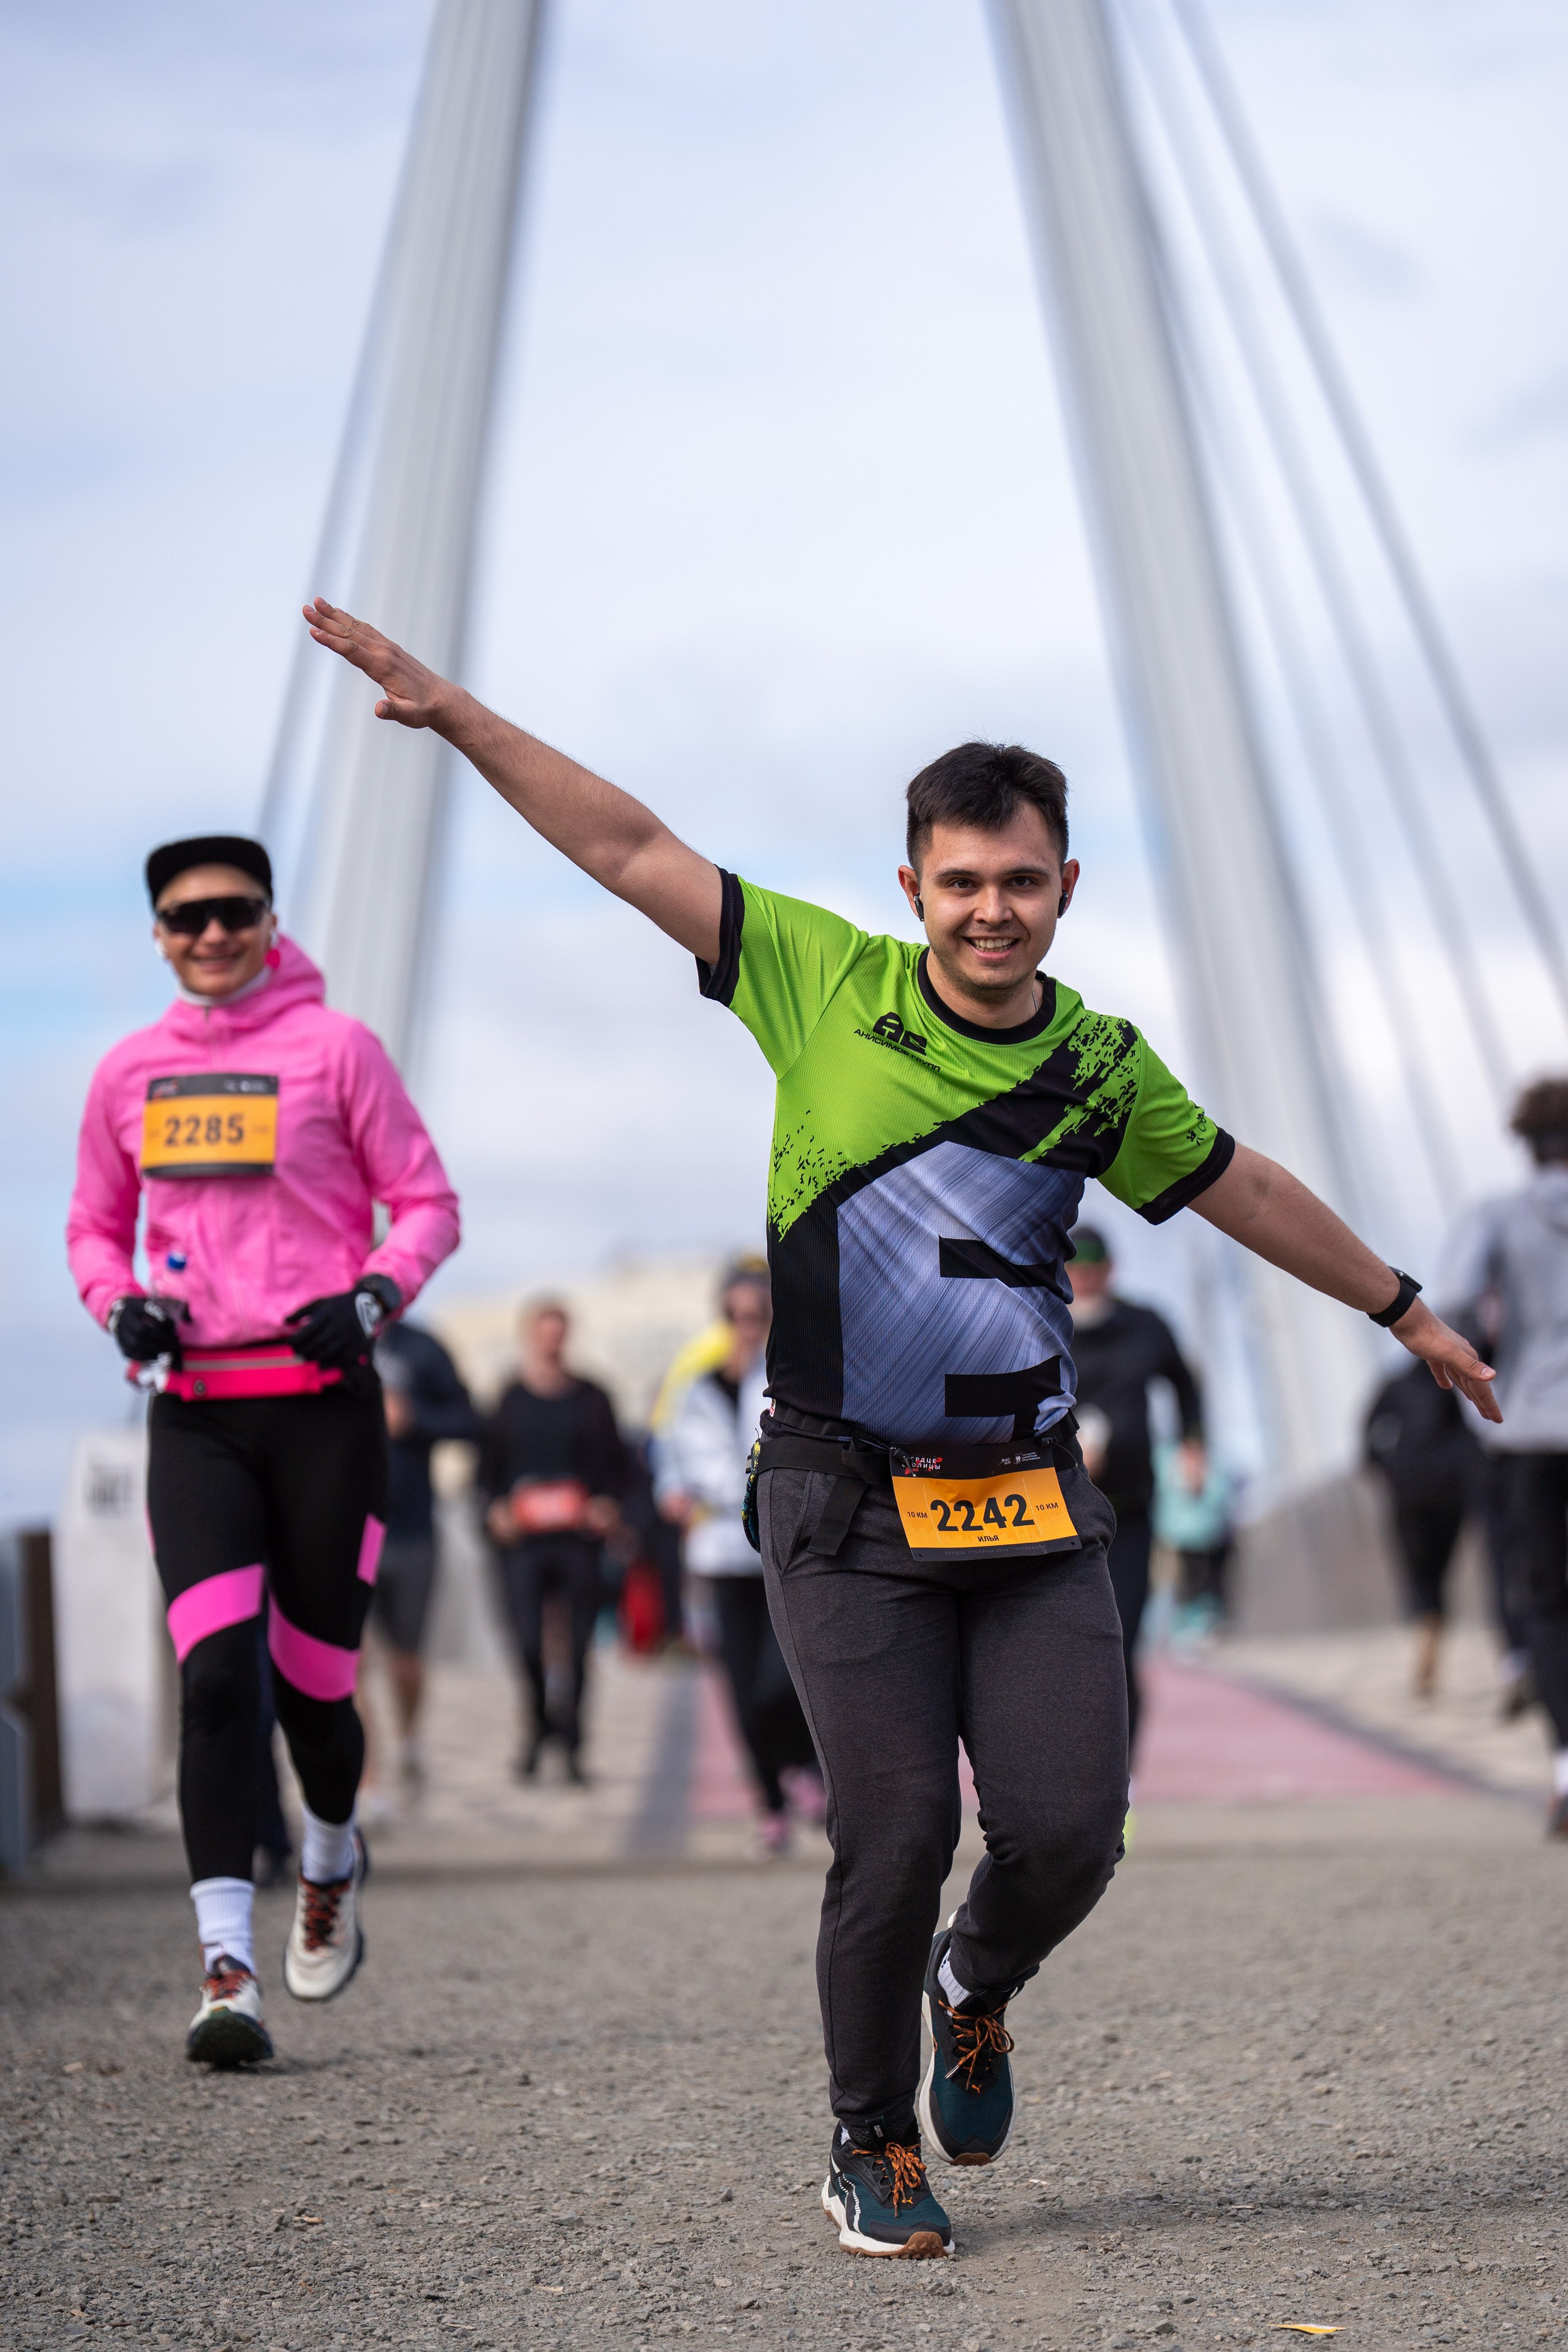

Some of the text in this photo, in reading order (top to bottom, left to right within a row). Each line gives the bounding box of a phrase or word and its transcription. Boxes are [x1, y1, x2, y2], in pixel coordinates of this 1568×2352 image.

[854, 1029, 910, 1056] АНИСИМОВ
[164, 1114, 244, 1148] 2285
[930, 1494, 1035, 1531] 2242
